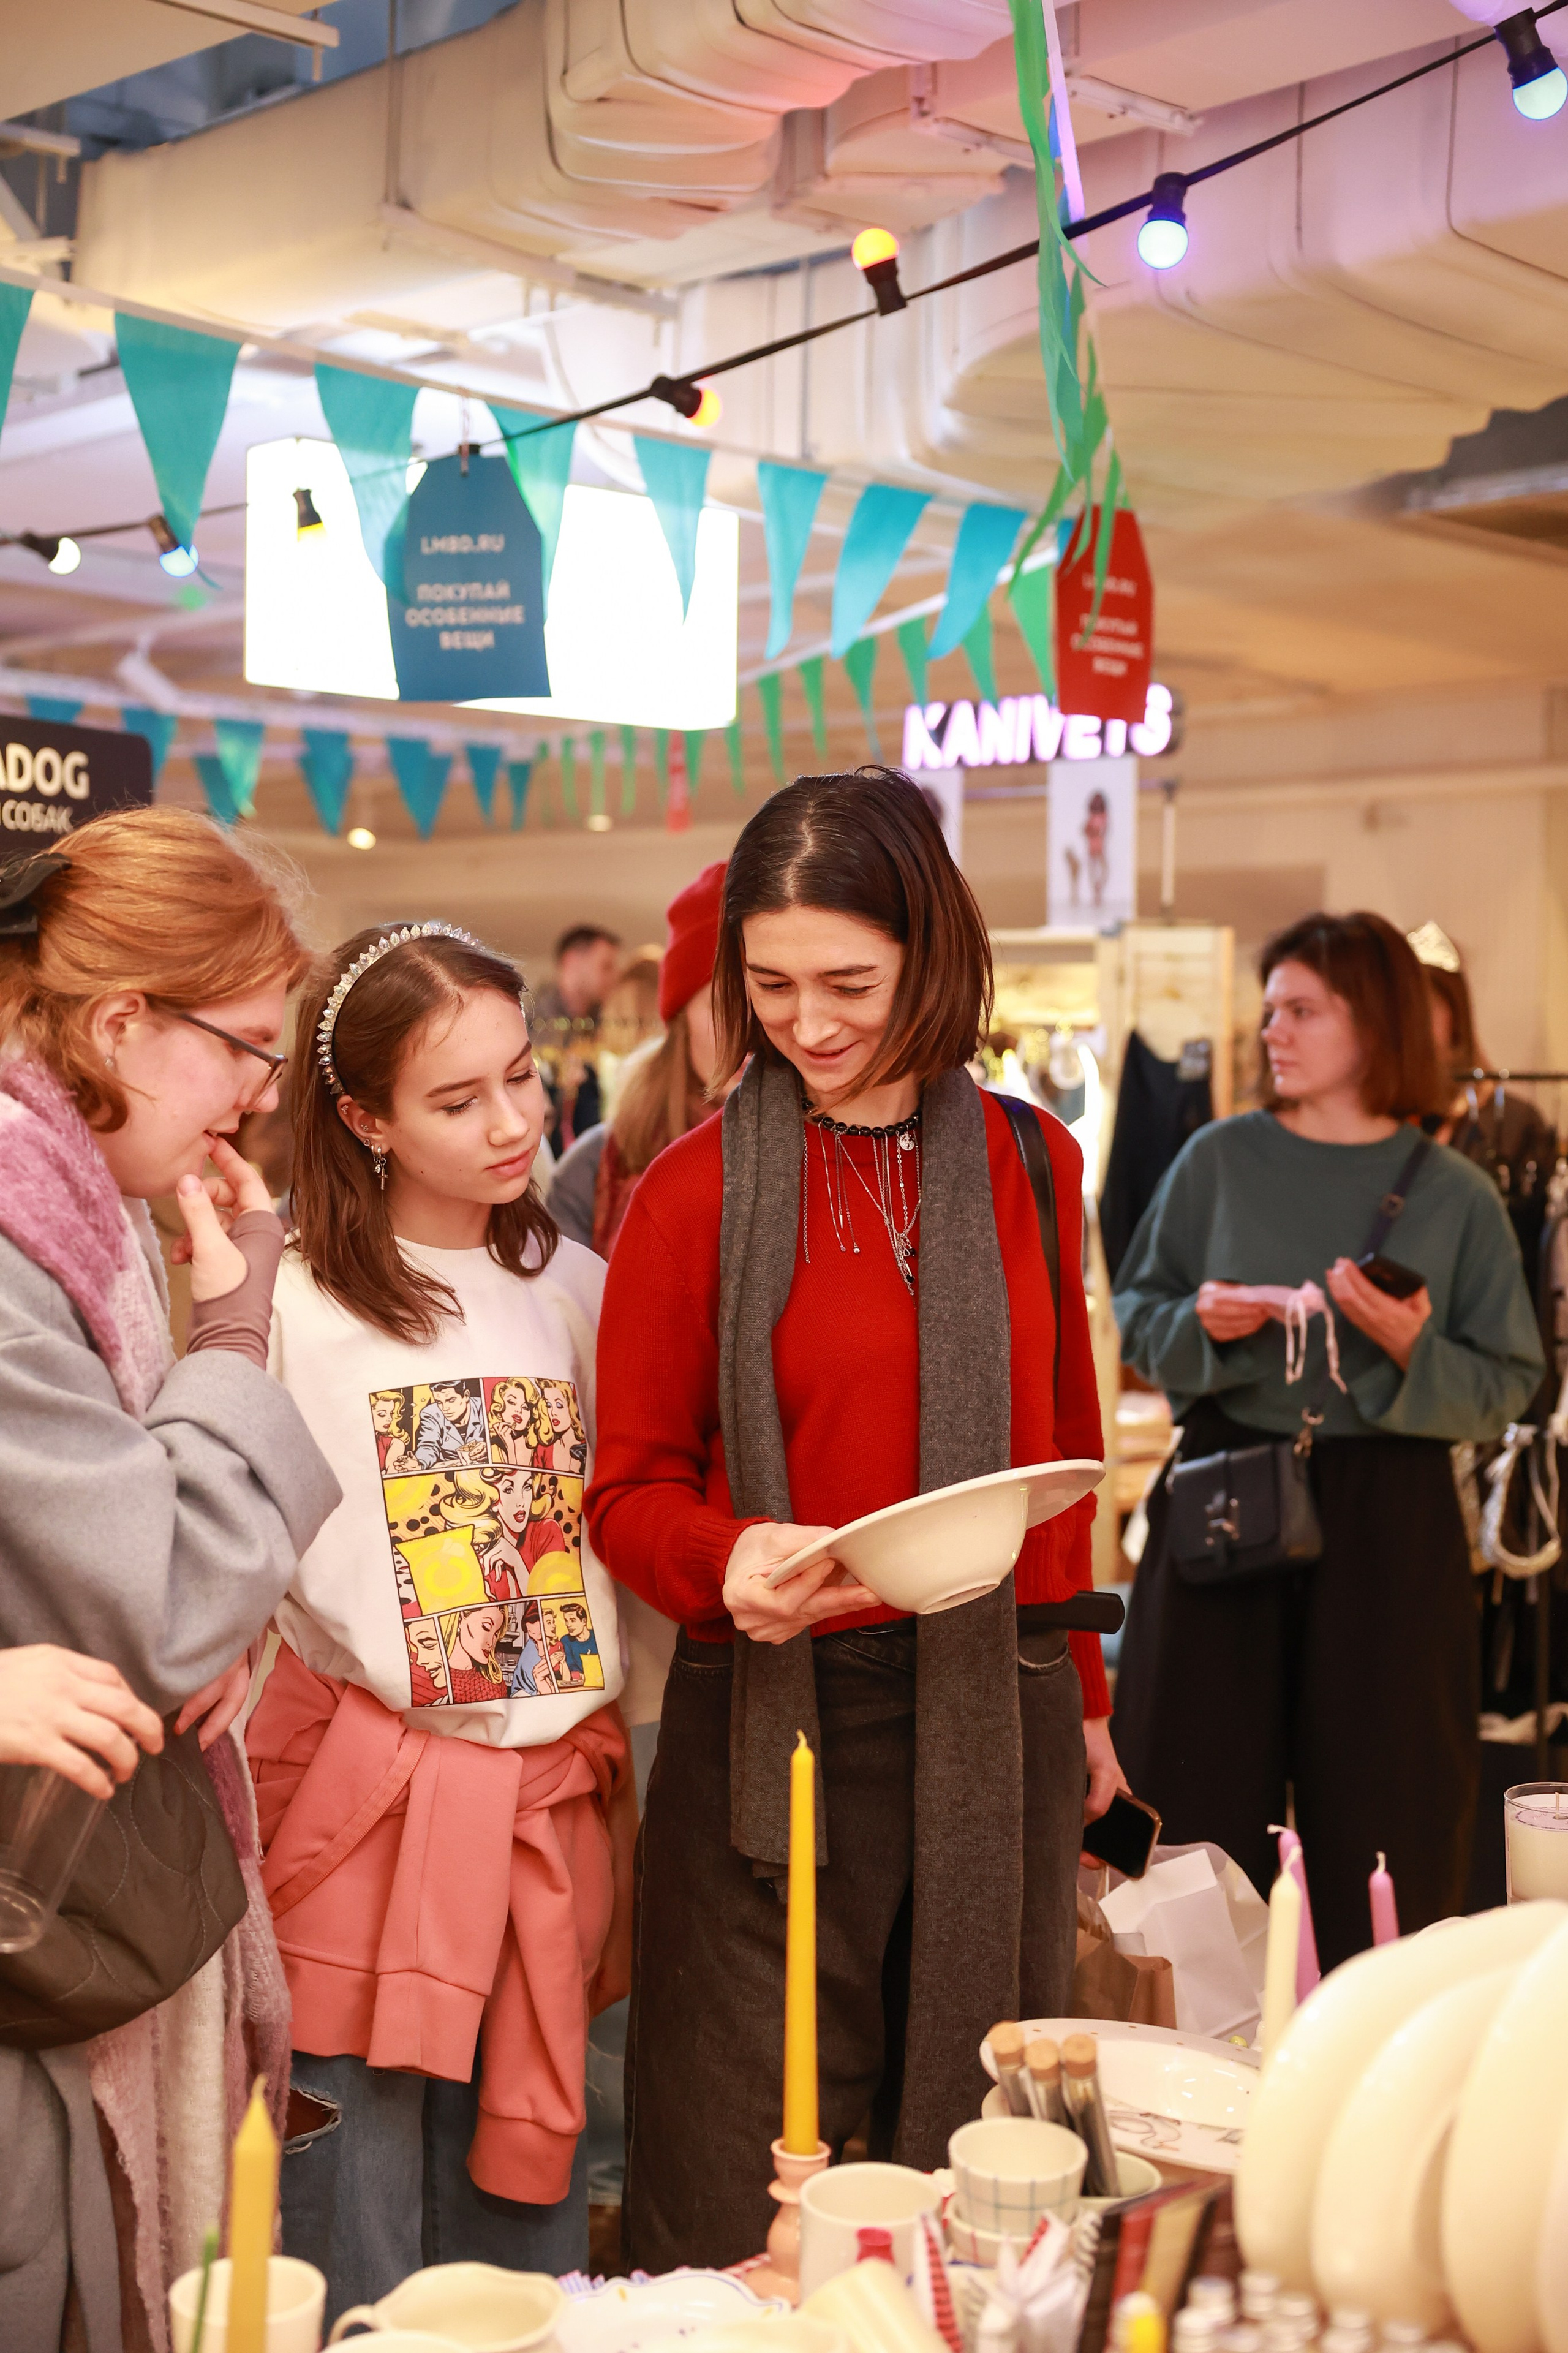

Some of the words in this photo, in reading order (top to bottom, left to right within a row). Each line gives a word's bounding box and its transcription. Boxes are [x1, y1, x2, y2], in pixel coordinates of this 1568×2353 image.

[417, 580, 511, 601] ПОКУПАЙ
[405, 605, 525, 627] ОСОБЕННЫЕ
[439, 630, 495, 651] ВЕЩИ
[0, 742, 90, 800] DOG
